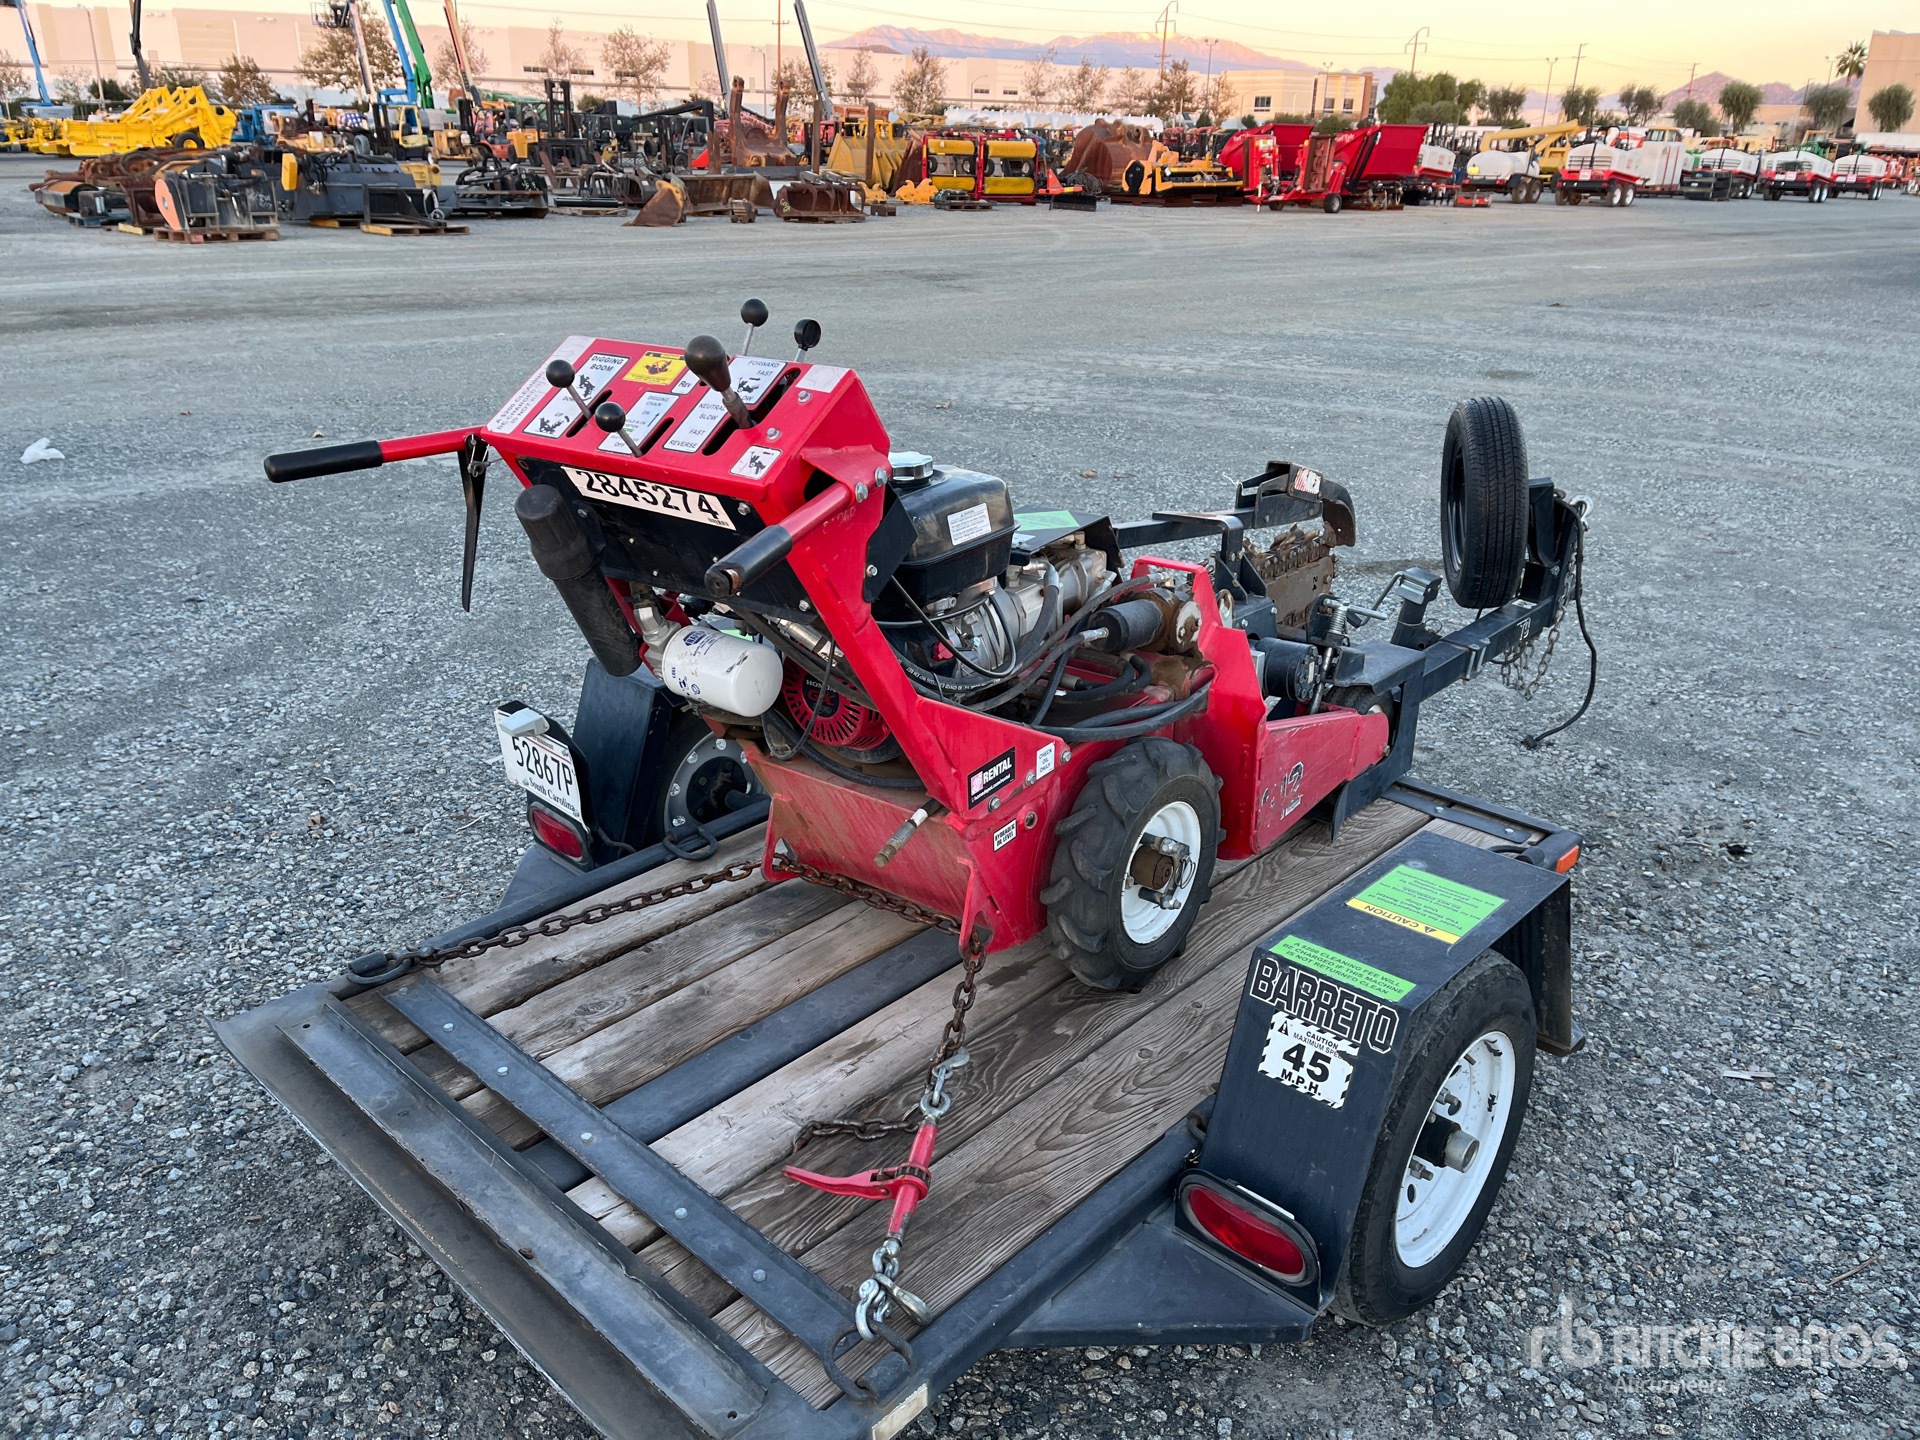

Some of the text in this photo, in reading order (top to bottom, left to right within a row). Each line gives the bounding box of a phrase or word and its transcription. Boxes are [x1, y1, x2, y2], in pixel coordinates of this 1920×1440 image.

[590, 363, 613, 372] BOOM
[592, 355, 624, 364] DIGGING
[699, 403, 726, 411] NEUTRAL
[669, 440, 698, 449] REVERSE
[576, 471, 720, 519] 2845274
[1039, 748, 1052, 759] CHECK
[512, 736, 572, 796] 52867P
[983, 757, 1012, 784] RENTAL
[1040, 763, 1051, 772] DAILY
[529, 777, 575, 811] South Carolina
[1003, 830, 1013, 842] LEVEL
[1375, 892, 1399, 902] Rental
[1399, 900, 1422, 910] Depot
[1363, 904, 1420, 927] CAUTION
[1422, 909, 1444, 918] Home
[1294, 948, 1335, 966] CHARGED
[1344, 968, 1363, 977] THIS
[1363, 976, 1403, 994] MACHINE
[1294, 954, 1313, 963] NOT
[1313, 961, 1359, 981] RETURNED
[1358, 980, 1389, 994] CLEAN
[1300, 944, 1319, 953] $200
[1319, 952, 1362, 970] CLEANING
[1362, 969, 1379, 978] FEE
[1380, 976, 1402, 987] WILL
[1250, 958, 1400, 1054] BARRETO
[1293, 1032, 1324, 1050] MAXIMUM
[1306, 1031, 1338, 1049] CAUTION
[1283, 1044, 1331, 1082] 45
[1280, 1068, 1321, 1096] M.P.H.
